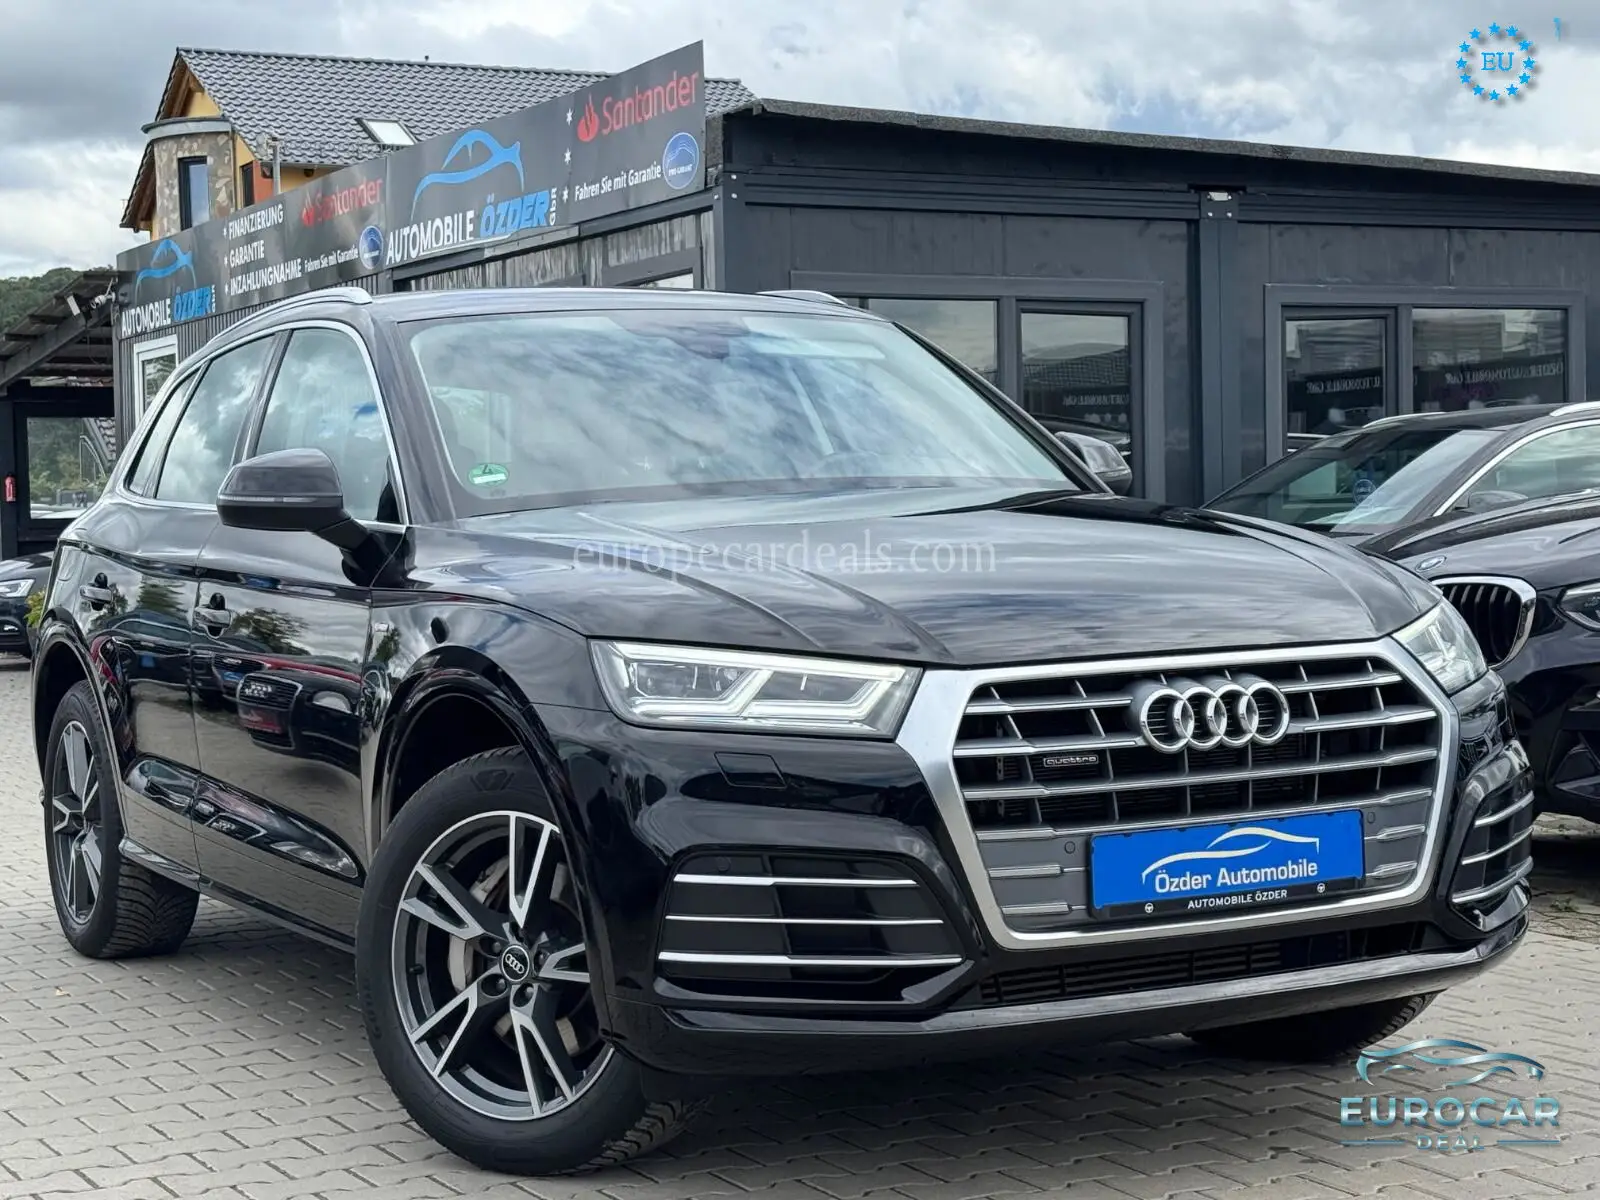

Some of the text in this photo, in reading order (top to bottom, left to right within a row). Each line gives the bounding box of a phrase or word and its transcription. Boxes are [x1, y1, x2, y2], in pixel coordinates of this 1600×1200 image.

[602, 71, 699, 135] Santander
[575, 160, 662, 201] Fahren Sie mit Garantie
[314, 177, 383, 225] Santander
[228, 203, 284, 240] FINANZIERUNG
[386, 188, 549, 266] AUTOMOBILE ÖZDER
[229, 240, 265, 268] GARANTIE
[304, 257, 320, 273] Fahren
[336, 244, 359, 264] Garantie
[230, 258, 302, 296] INZAHLUNGNAHME
[121, 298, 171, 338] AUTOMOBILE
[1046, 755, 1097, 765] quattro
[1155, 859, 1318, 893] Özder Automobile
[1187, 889, 1287, 910] AUTOMOBILE ÖZDER
